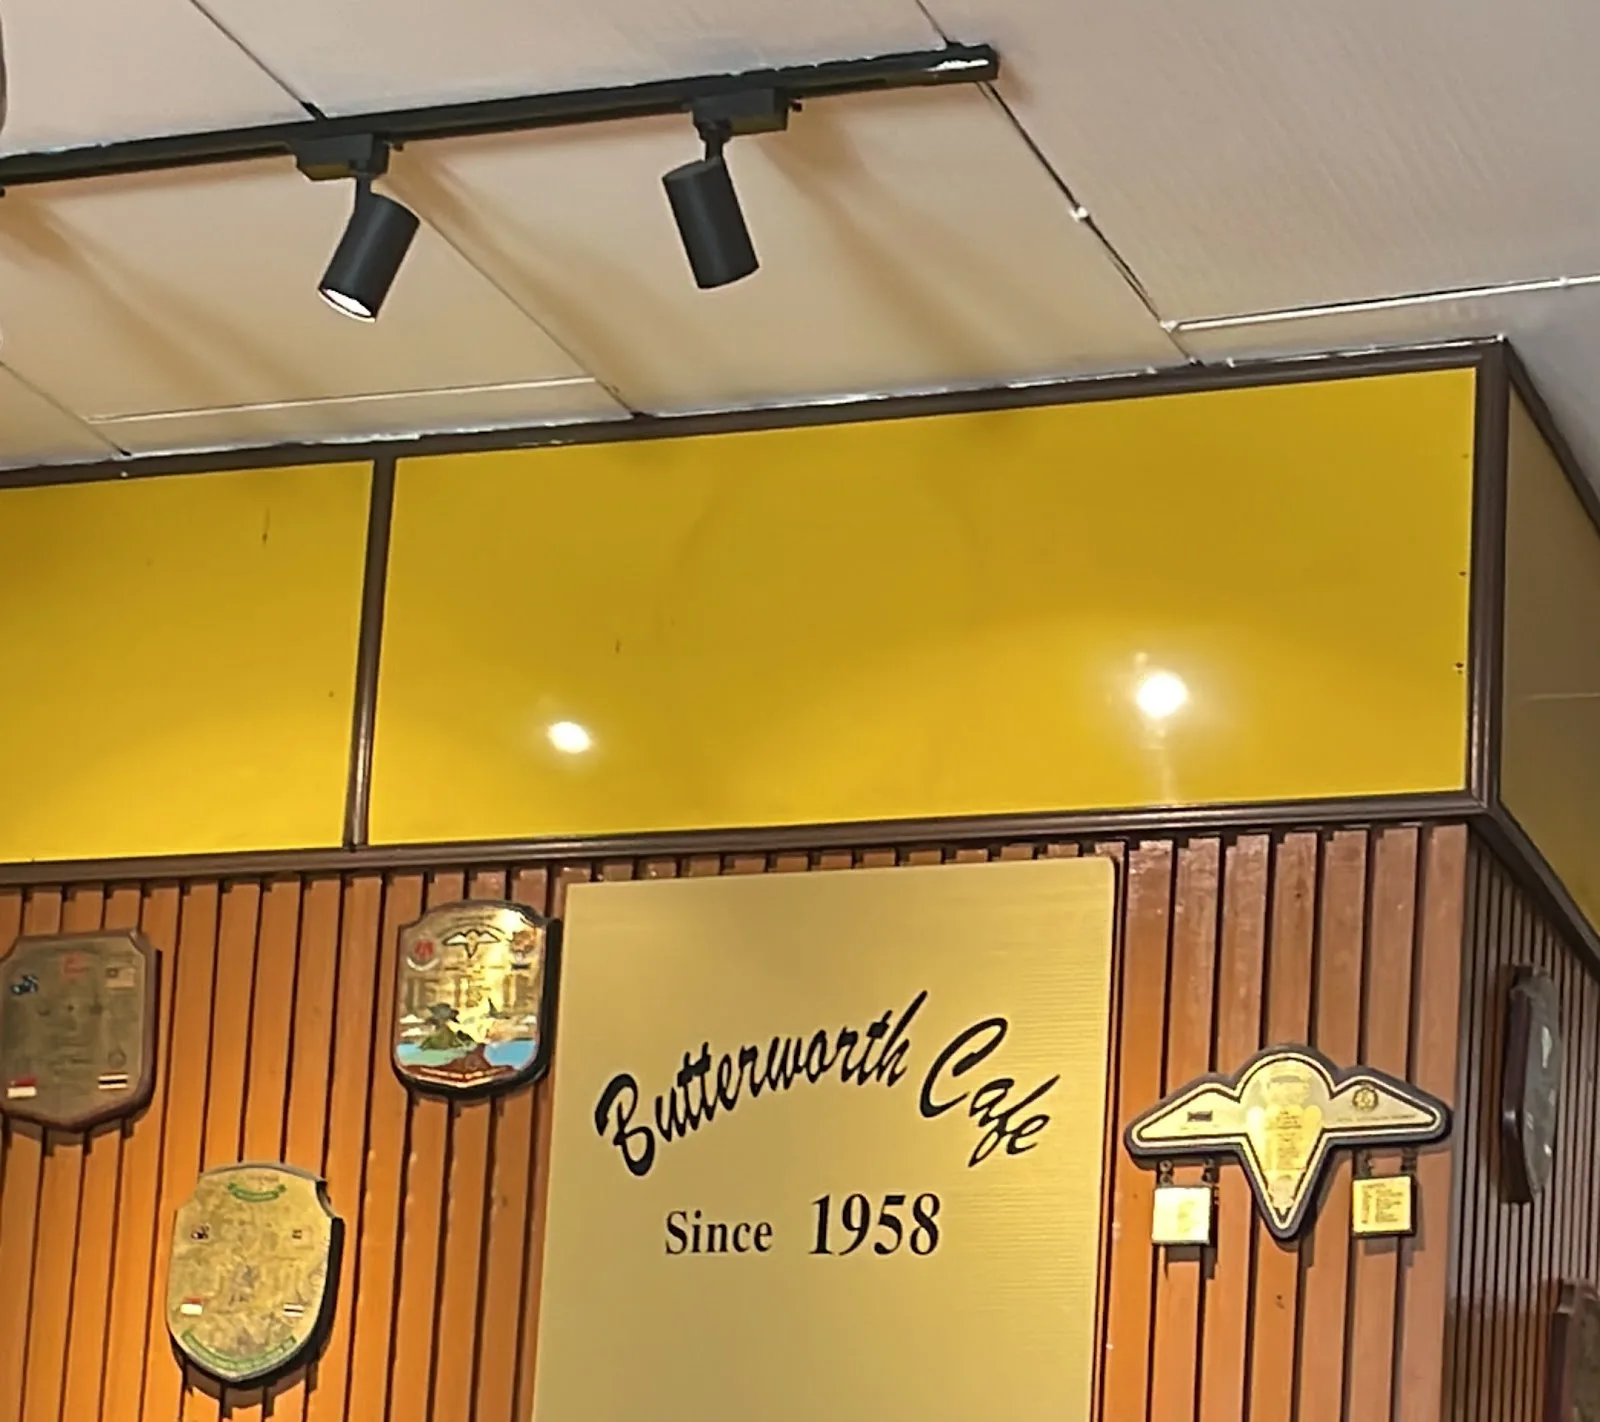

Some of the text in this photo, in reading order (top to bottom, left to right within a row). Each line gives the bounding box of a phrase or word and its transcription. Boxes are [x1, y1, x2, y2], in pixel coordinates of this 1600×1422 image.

[595, 990, 1061, 1176] Butterworth Cafe
[665, 1193, 941, 1256] Since 1958
